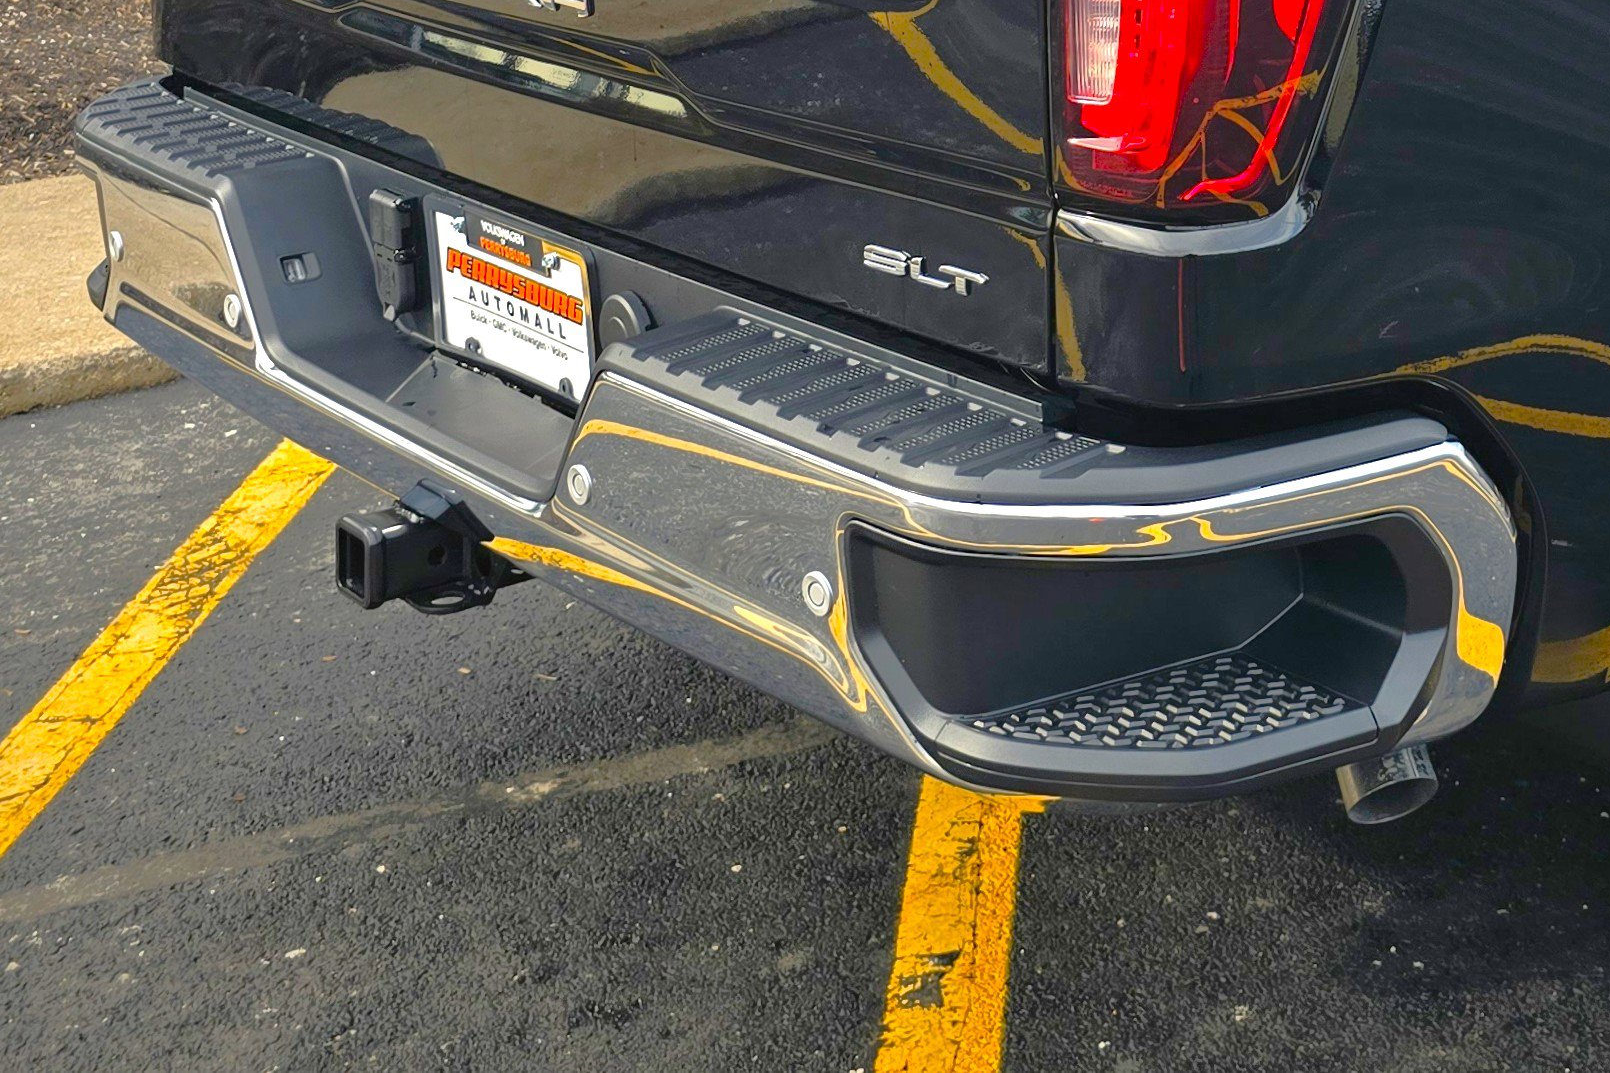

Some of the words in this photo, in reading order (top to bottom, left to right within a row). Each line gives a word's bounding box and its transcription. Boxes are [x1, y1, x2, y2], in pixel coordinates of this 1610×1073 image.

[446, 247, 583, 326] PERRYSBURG
[863, 244, 989, 296] SLT
[468, 285, 567, 340] AUTOMALL
[470, 309, 488, 325] Buick
